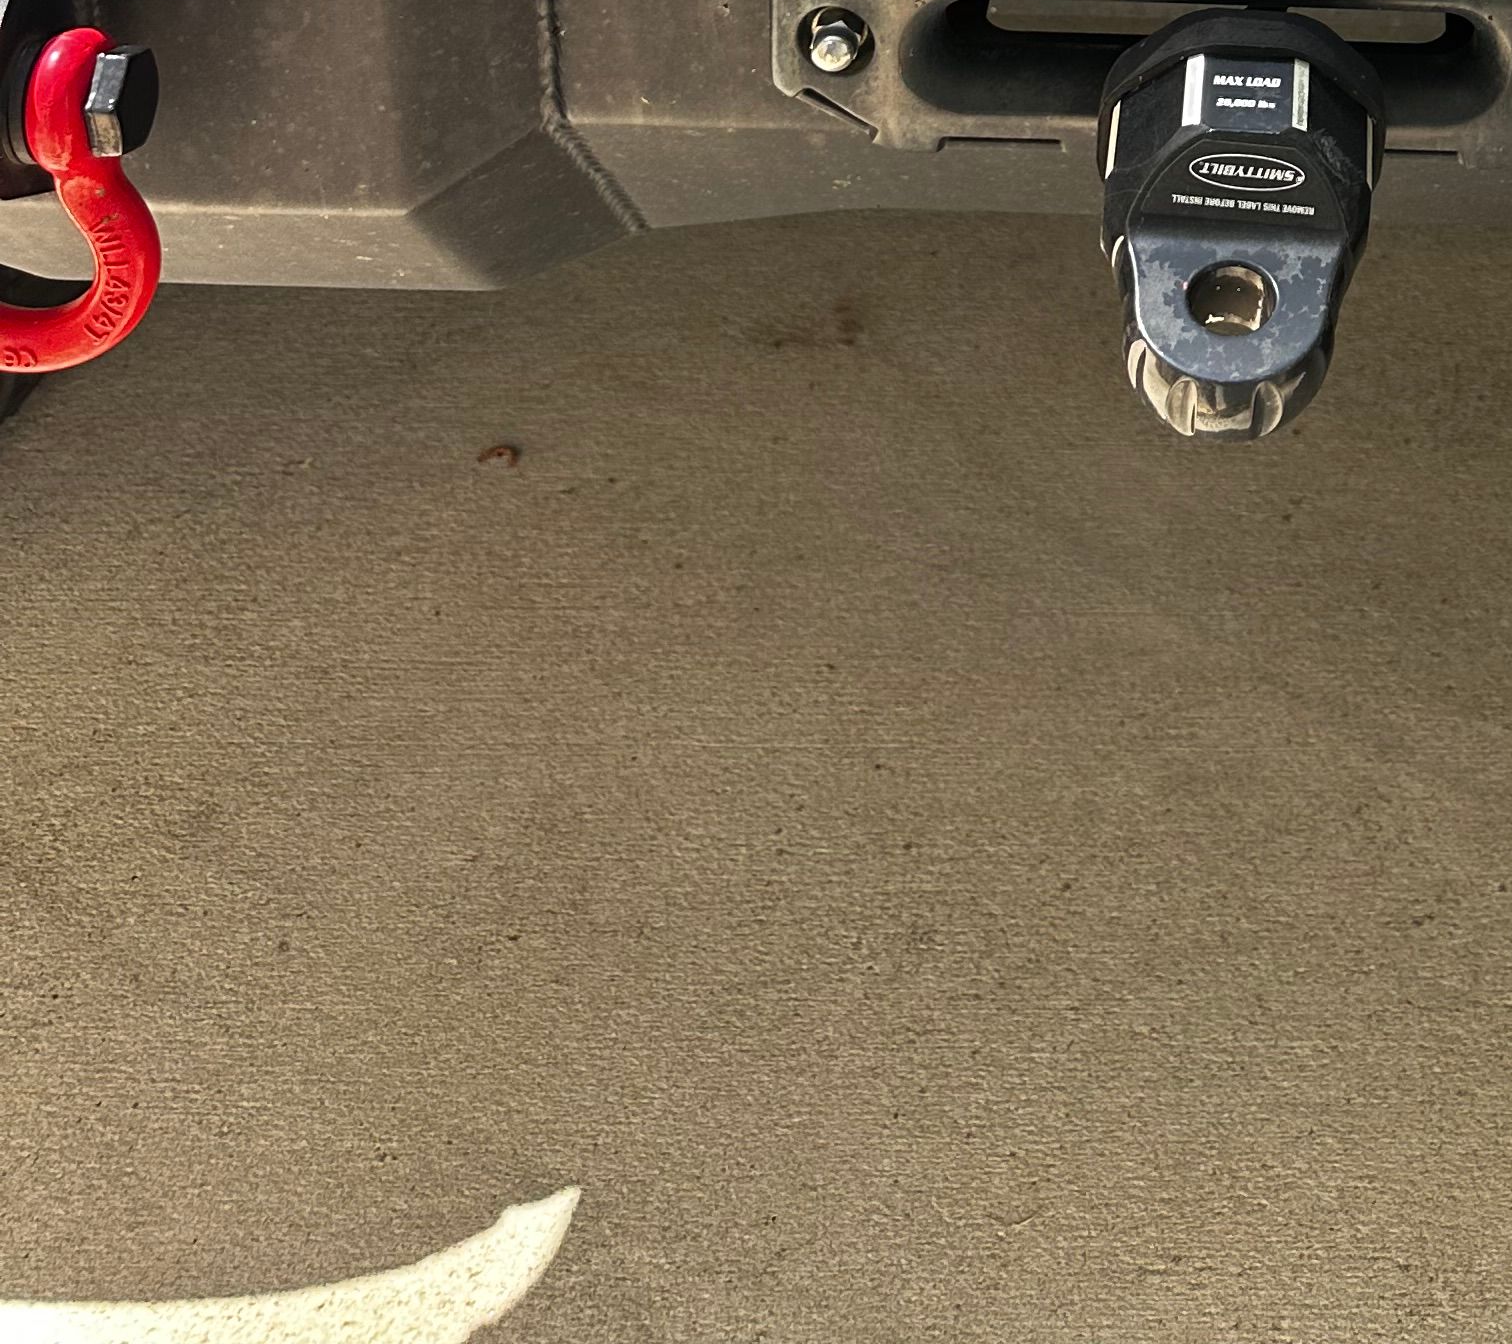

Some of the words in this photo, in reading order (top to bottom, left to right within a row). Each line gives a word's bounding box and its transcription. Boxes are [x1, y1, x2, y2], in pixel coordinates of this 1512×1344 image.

[1213, 75, 1244, 86] MAX
[1246, 77, 1281, 88] LOAD
[1199, 162, 1296, 181] SMITTYBILT
[1171, 194, 1203, 205] INSTALL
[1204, 197, 1235, 208] BEFORE
[1237, 199, 1261, 210] LABEL
[1263, 202, 1280, 212] THIS
[1281, 204, 1315, 215] REMOVE
